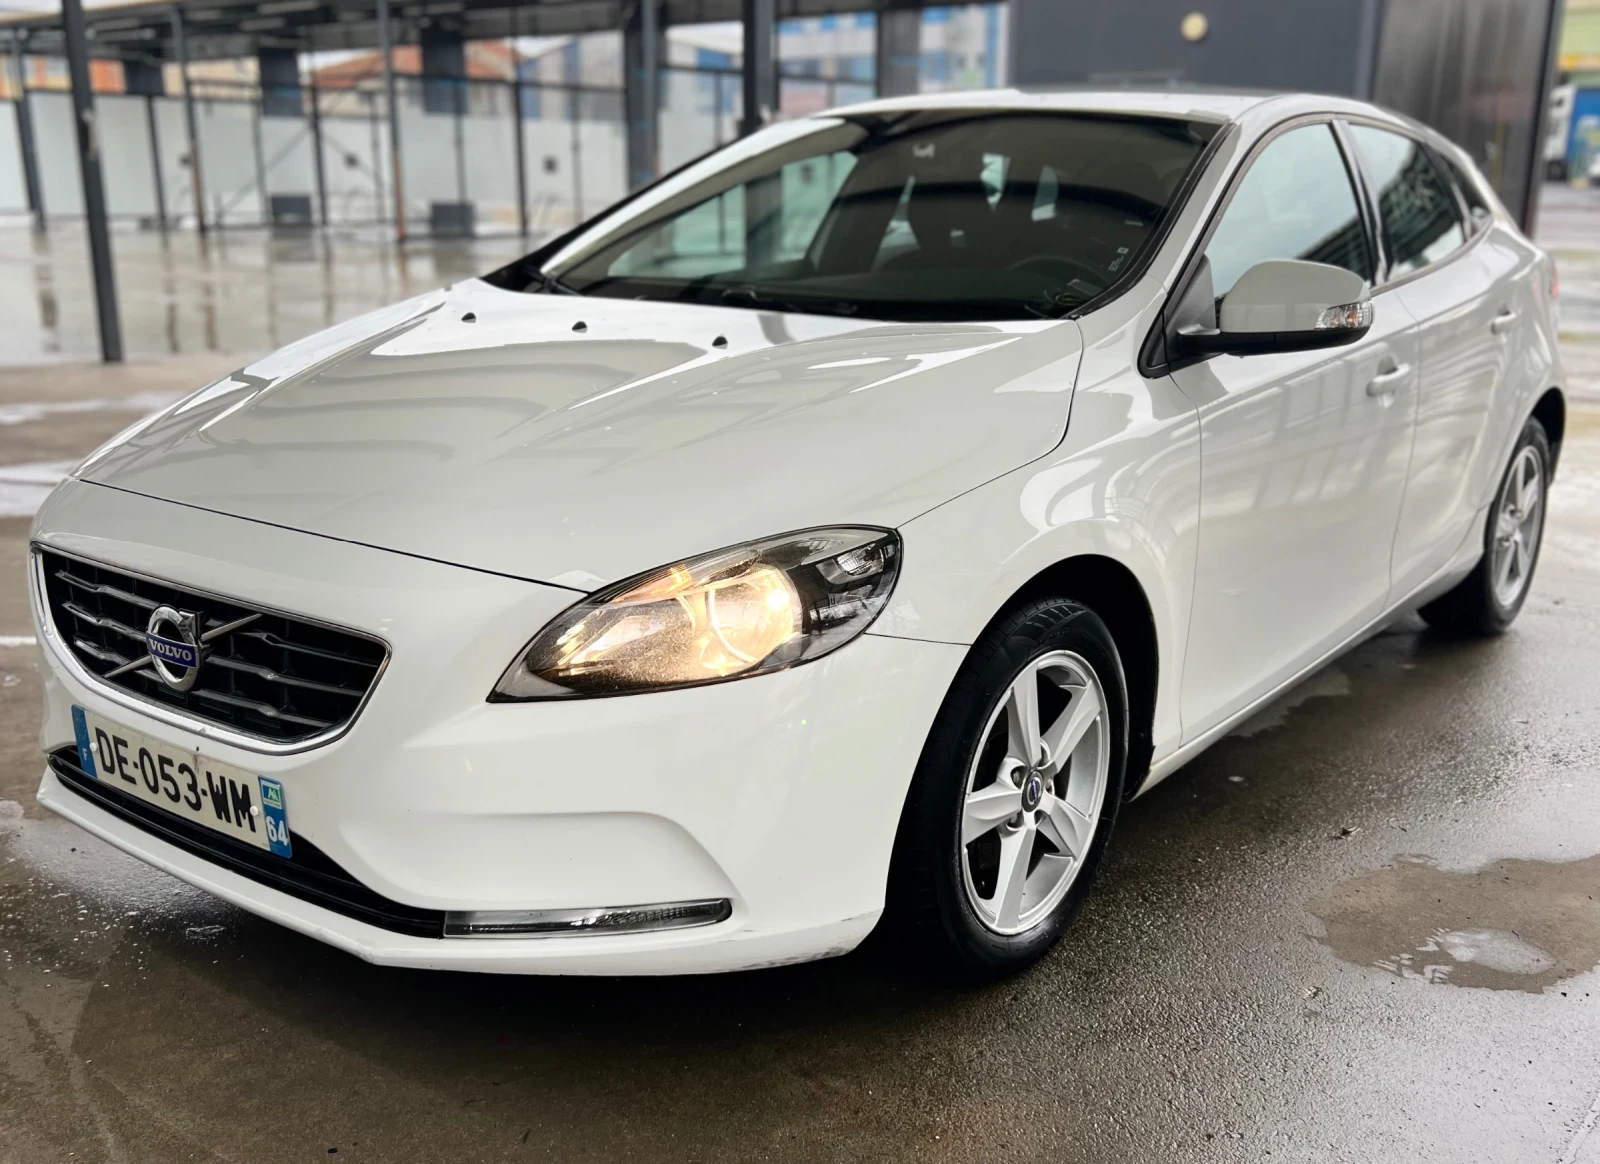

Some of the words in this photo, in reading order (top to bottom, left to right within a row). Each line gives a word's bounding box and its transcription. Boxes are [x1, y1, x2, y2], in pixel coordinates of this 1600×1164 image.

[149, 638, 193, 661] VOLVO
[82, 747, 88, 761] F
[95, 726, 256, 833] DE-053-WM
[265, 815, 290, 847] 64
